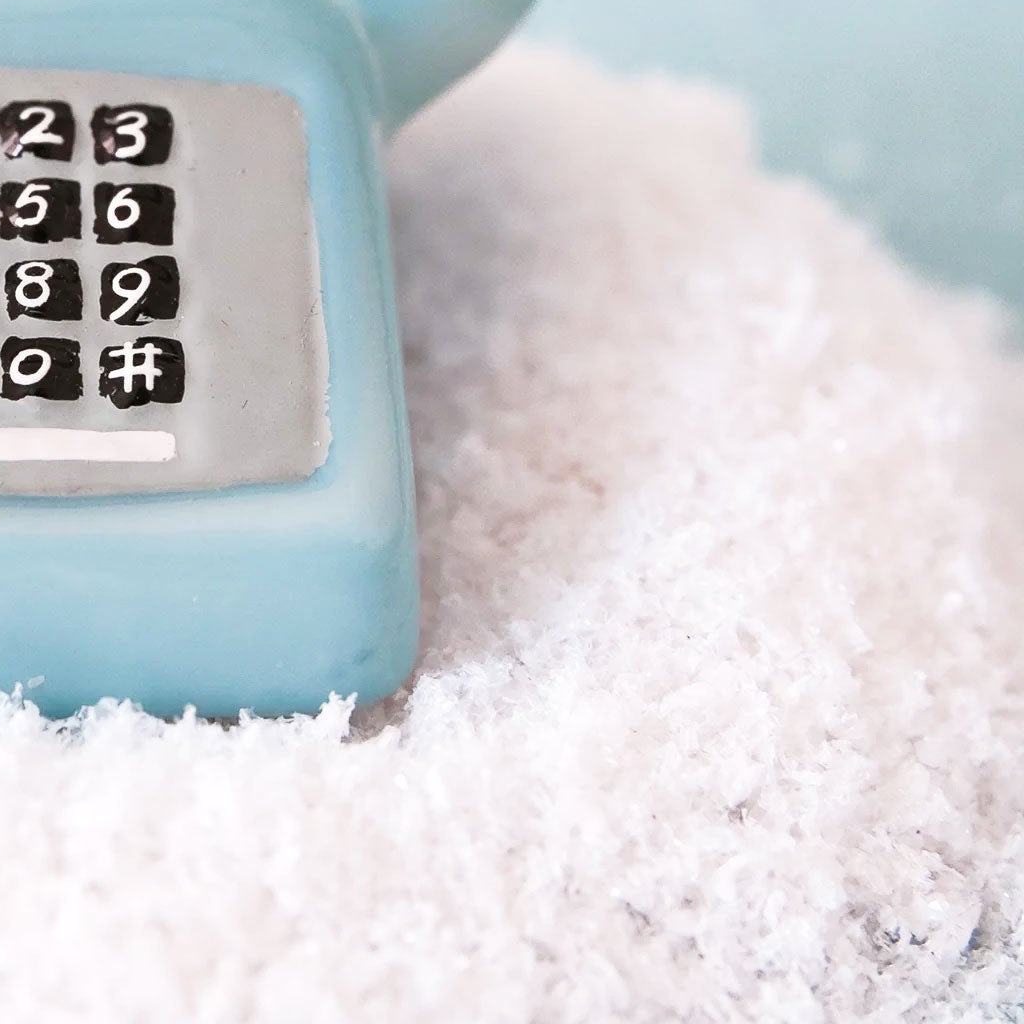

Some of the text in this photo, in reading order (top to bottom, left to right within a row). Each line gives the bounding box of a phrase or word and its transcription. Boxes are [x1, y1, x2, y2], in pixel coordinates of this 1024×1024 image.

[19, 106, 64, 145] 2
[111, 111, 148, 159] 3
[14, 183, 51, 228] 5
[106, 187, 140, 229] 6
[14, 261, 54, 308] 8
[109, 266, 151, 321] 9
[108, 341, 163, 393] #
